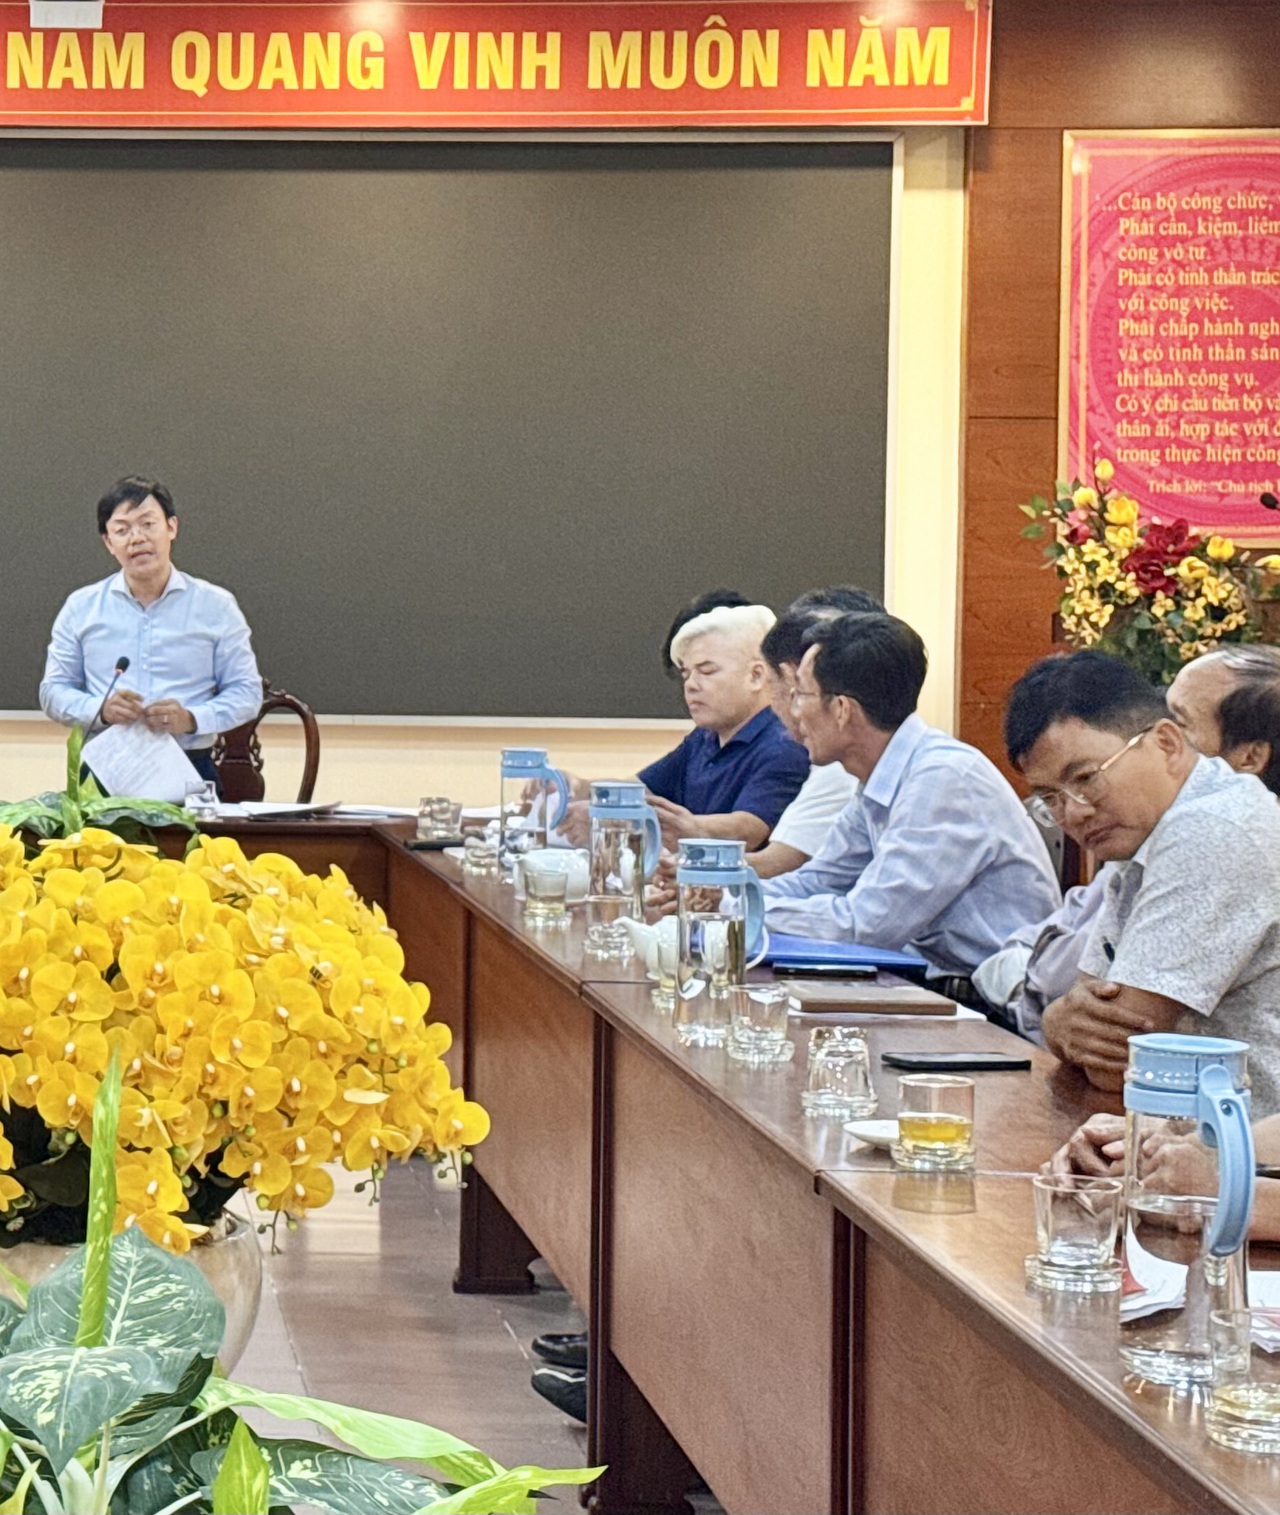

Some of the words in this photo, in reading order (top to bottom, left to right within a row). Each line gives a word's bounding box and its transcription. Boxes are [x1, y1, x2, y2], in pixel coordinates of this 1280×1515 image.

[6, 31, 147, 91] NAM
[171, 30, 385, 97] QUANG
[408, 31, 562, 91] VINH
[588, 15, 779, 91] MUÔN
[805, 15, 951, 89] NĂM
